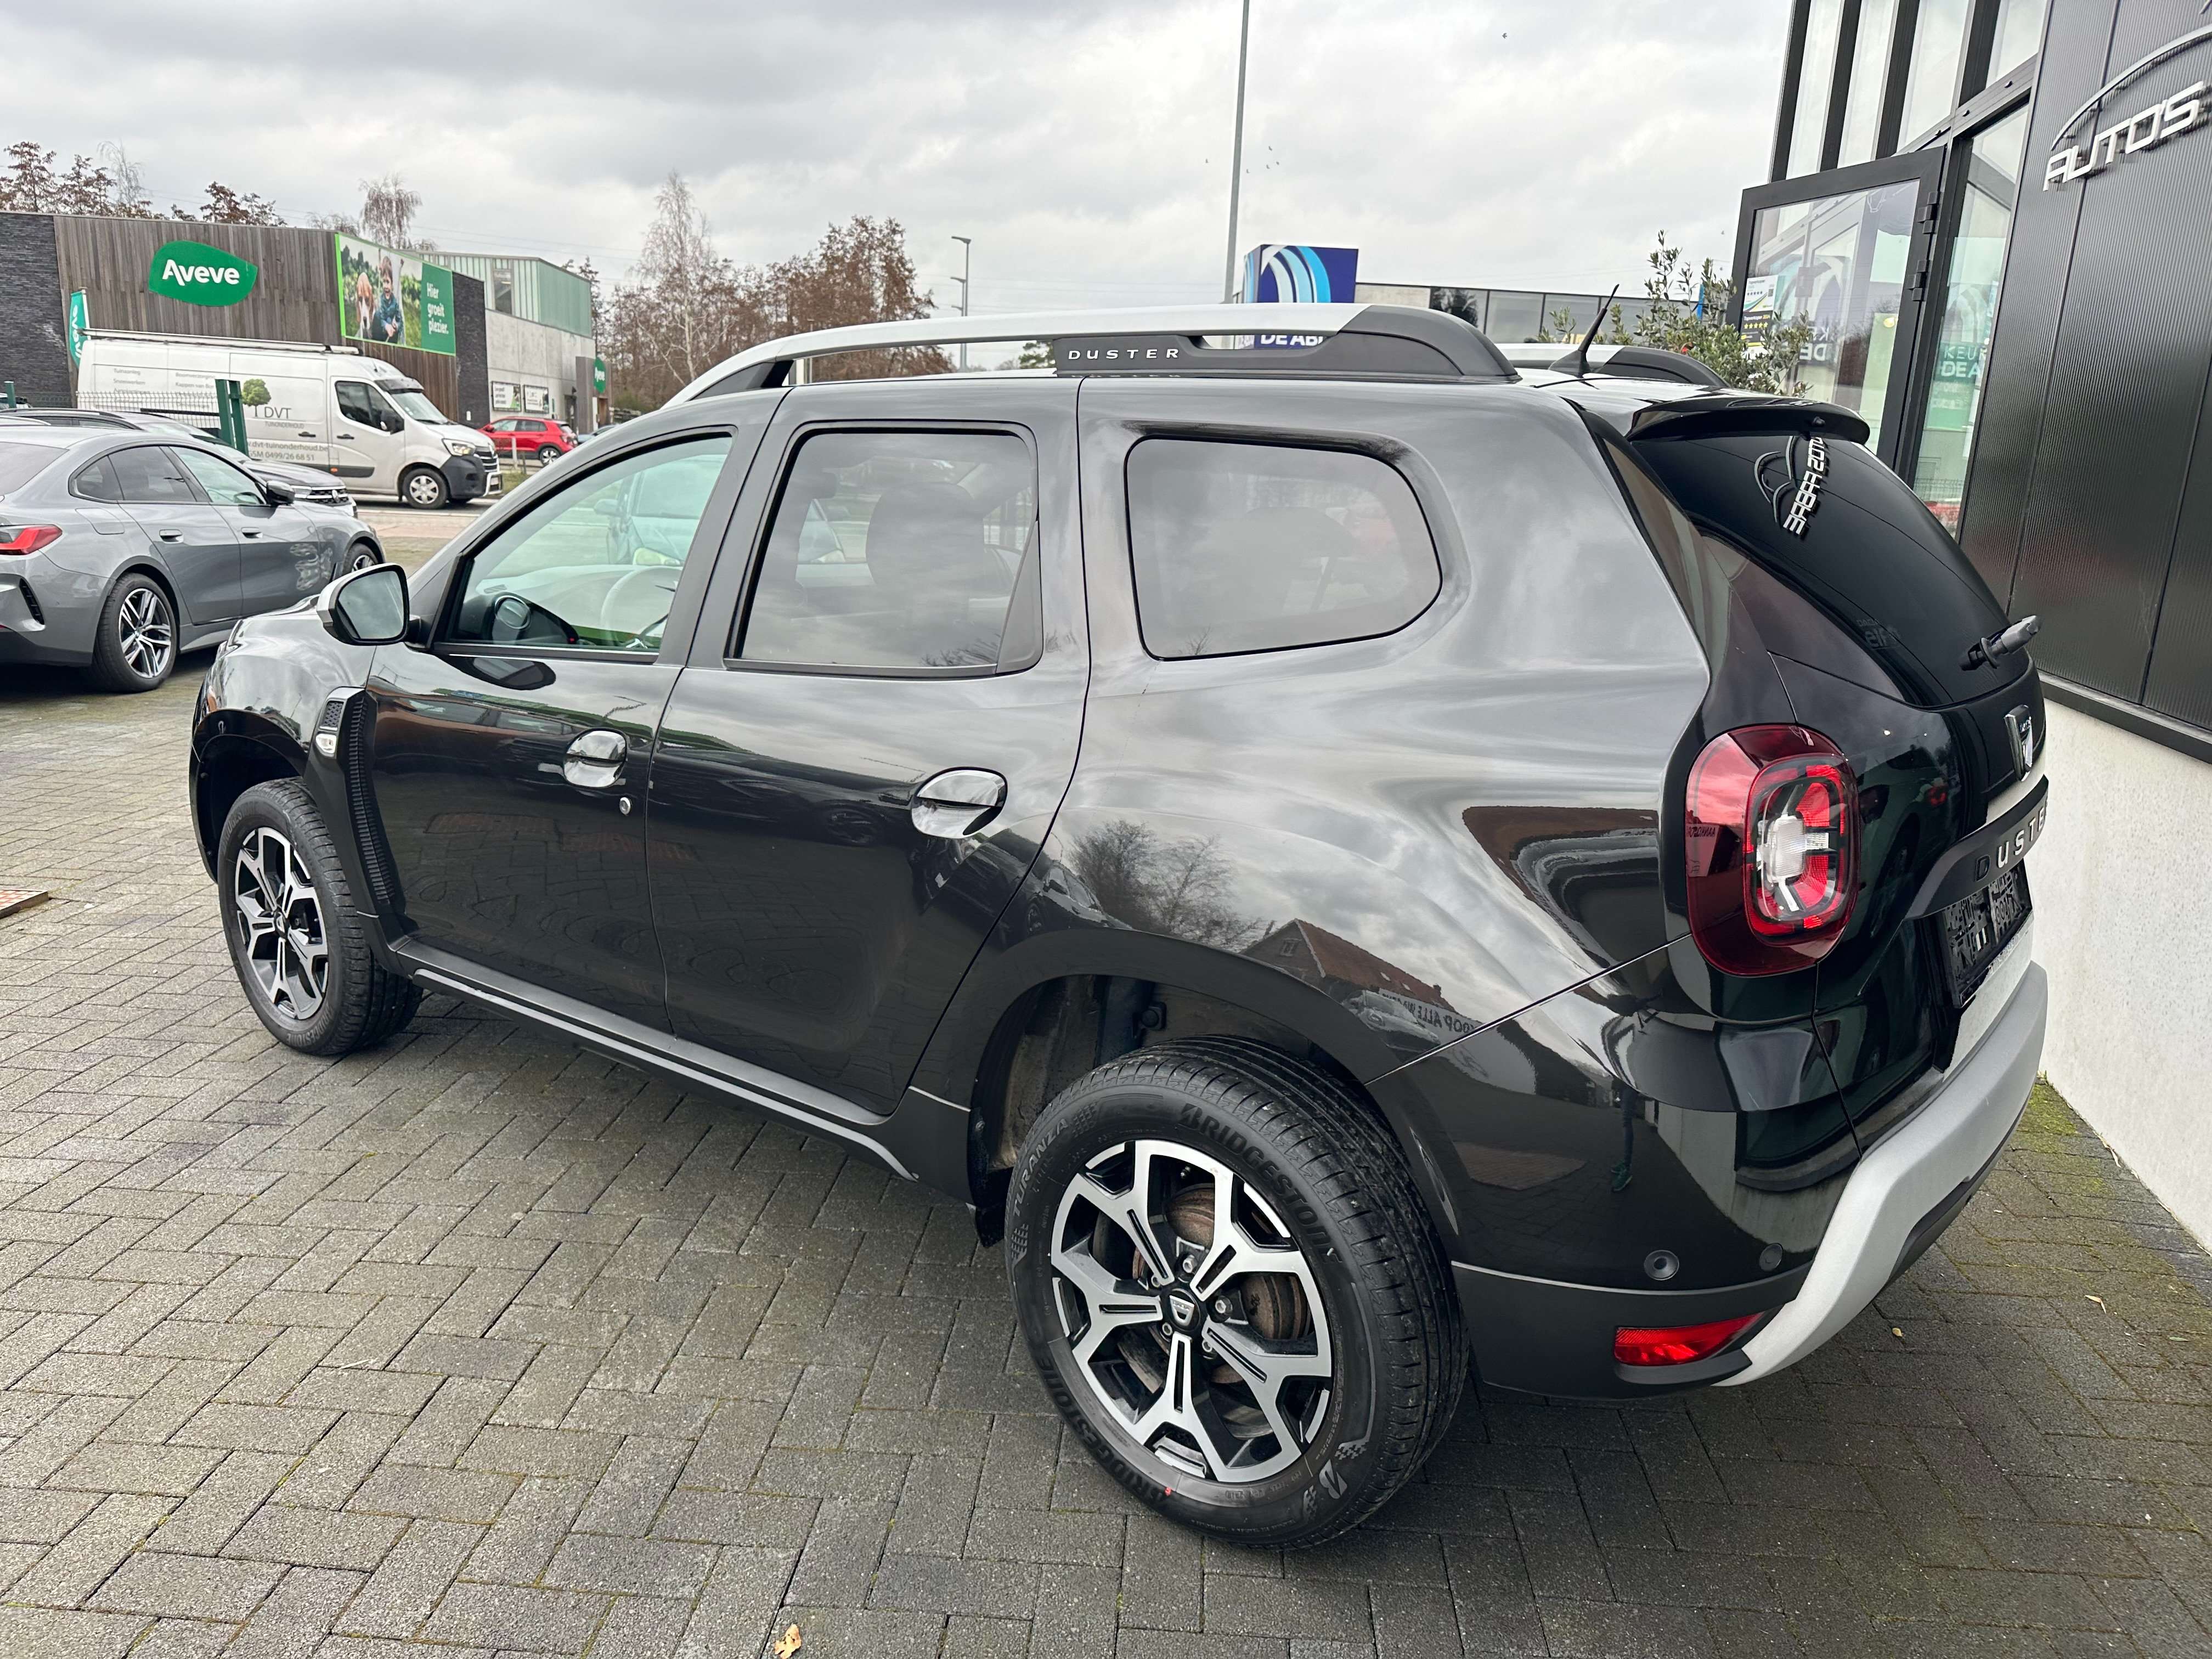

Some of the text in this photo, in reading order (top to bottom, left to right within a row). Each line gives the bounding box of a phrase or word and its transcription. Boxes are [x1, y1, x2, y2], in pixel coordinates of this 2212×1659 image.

[162, 259, 240, 286] Aveve
[427, 282, 439, 299] Hier
[427, 302, 445, 318] groeit
[428, 318, 449, 334] plezier.
[1068, 348, 1179, 359] DUSTER
[264, 406, 292, 419] DVT
[1013, 1118, 1068, 1217] TURANZA
[1178, 1103, 1343, 1264] BRIDGESTONE
